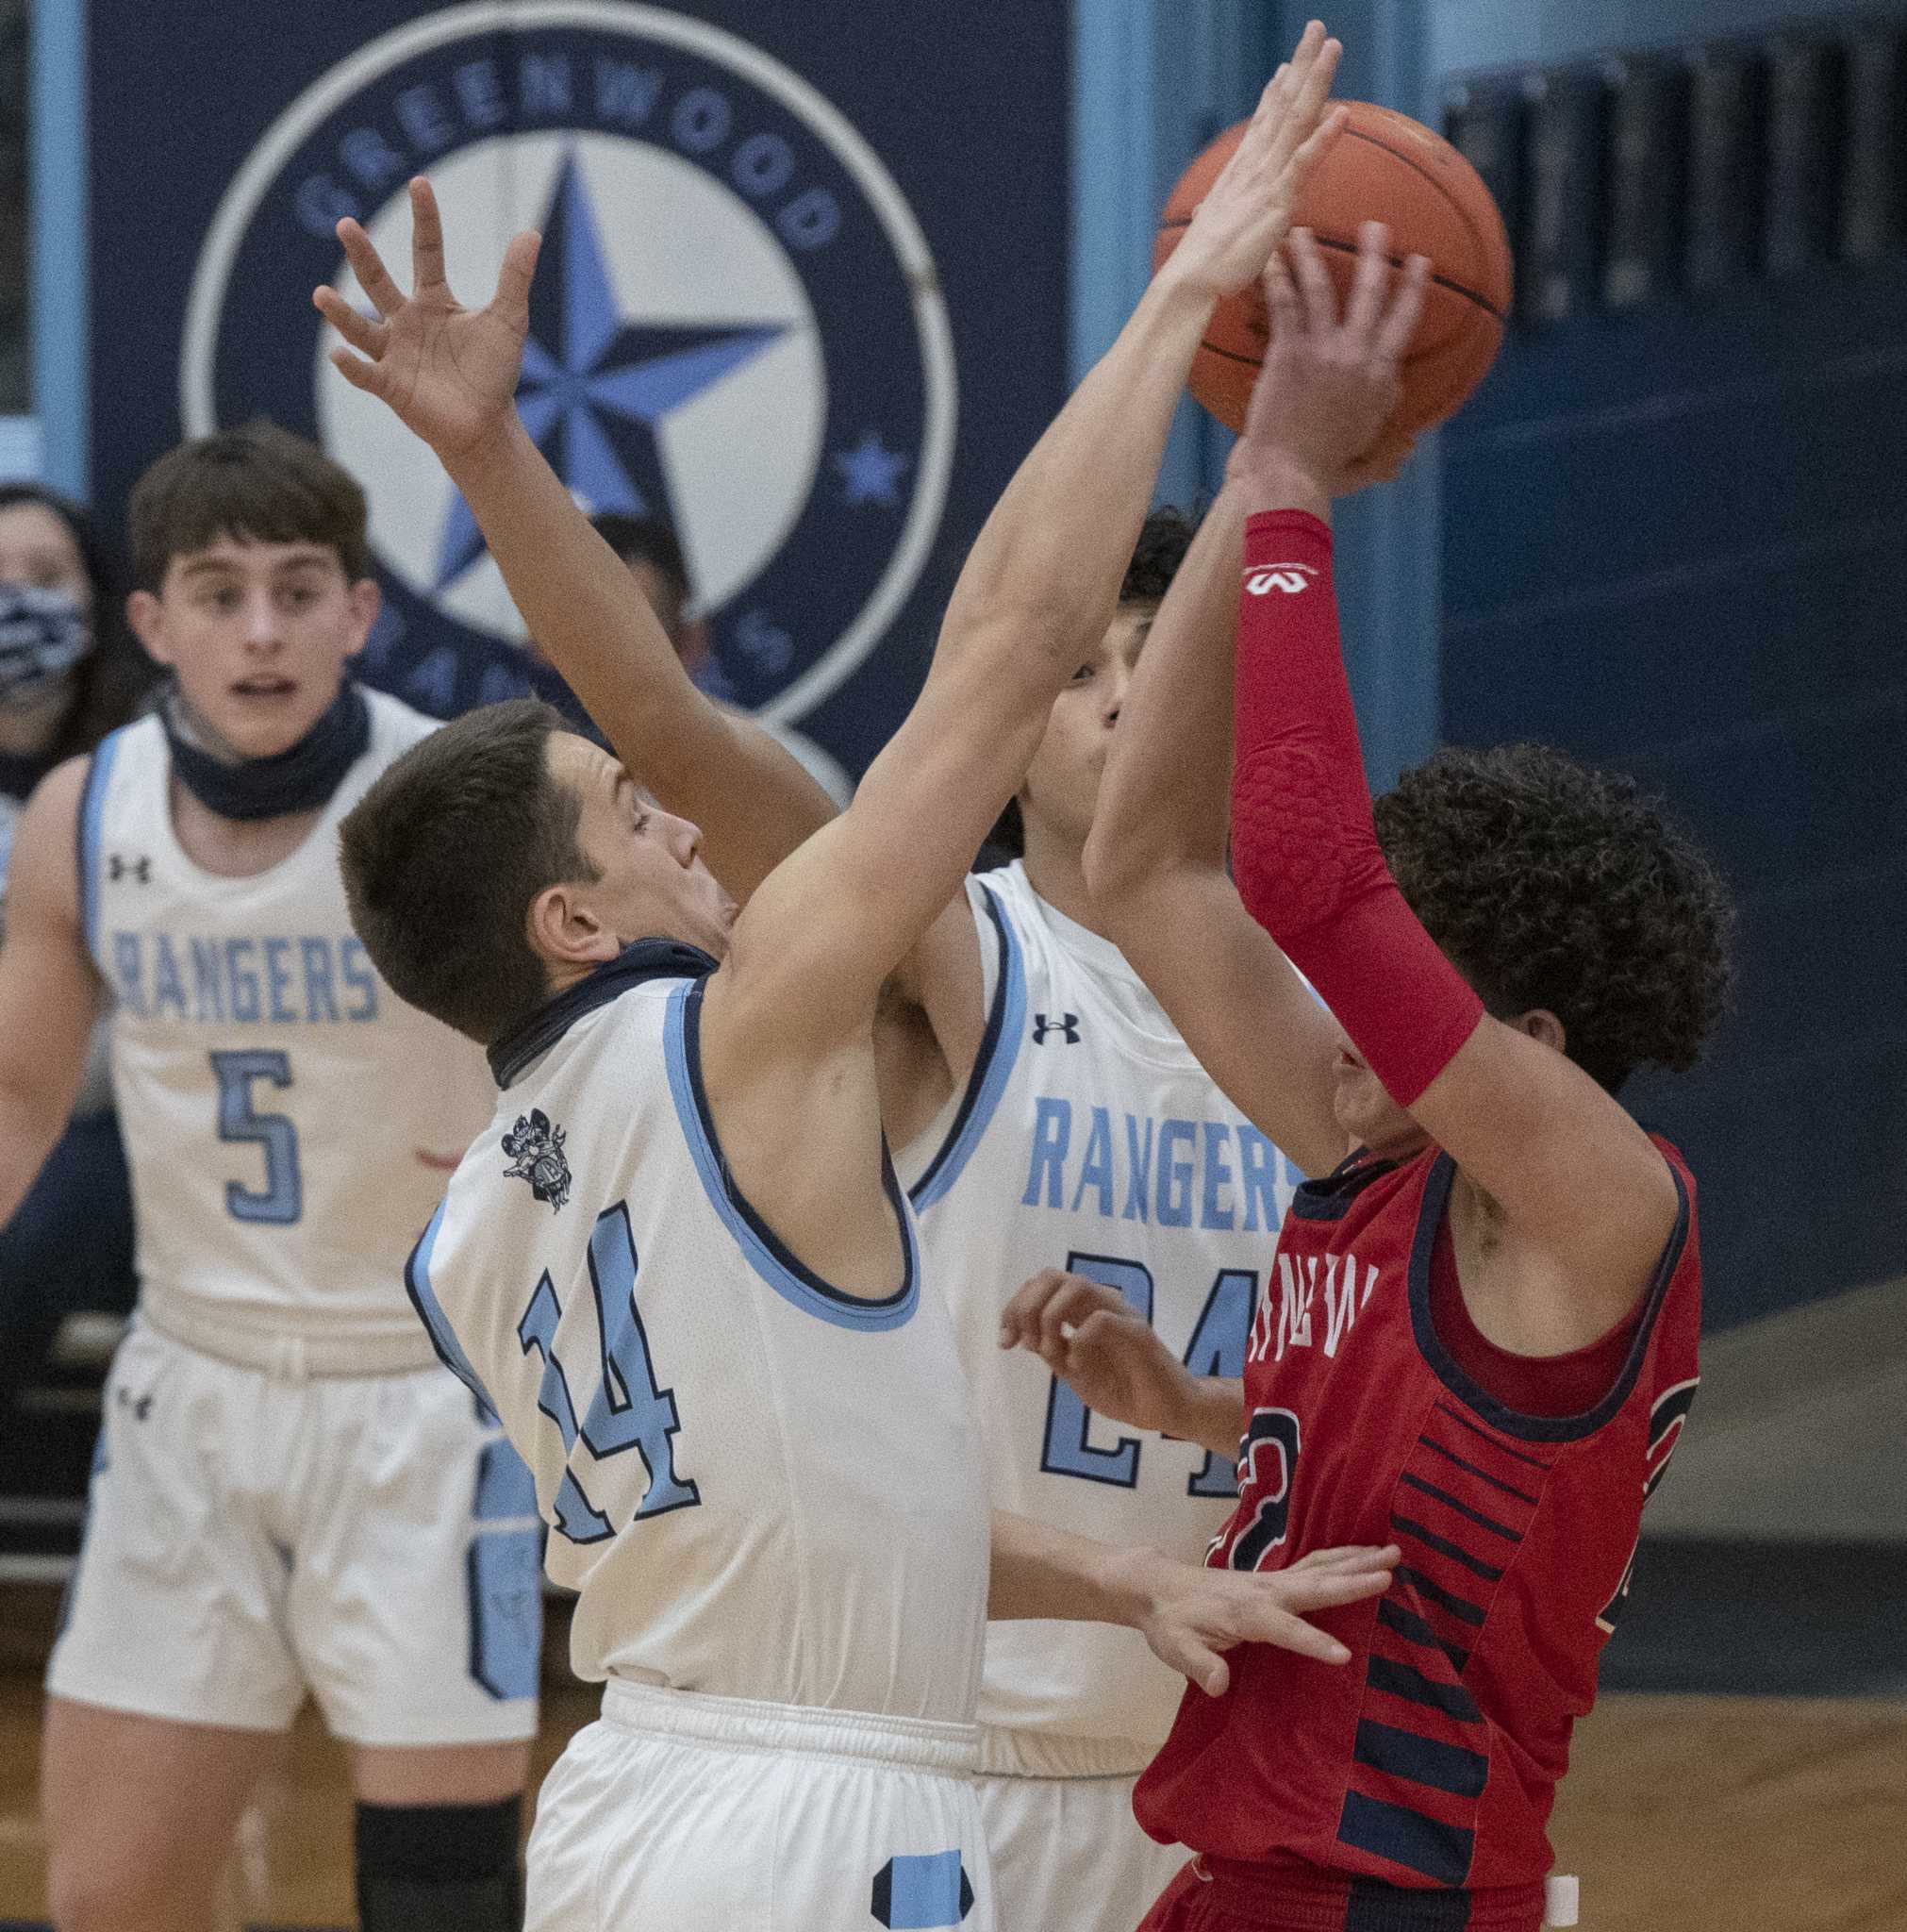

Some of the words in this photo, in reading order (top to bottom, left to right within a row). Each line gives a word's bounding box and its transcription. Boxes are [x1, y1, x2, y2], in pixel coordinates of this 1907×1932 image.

[294, 54, 842, 251] GREENWOOD
[111, 929, 379, 1024] RANGERS
[209, 1048, 304, 1225] 5
[1021, 1096, 1307, 1233] RANGER
[517, 1199, 702, 1544] 14
